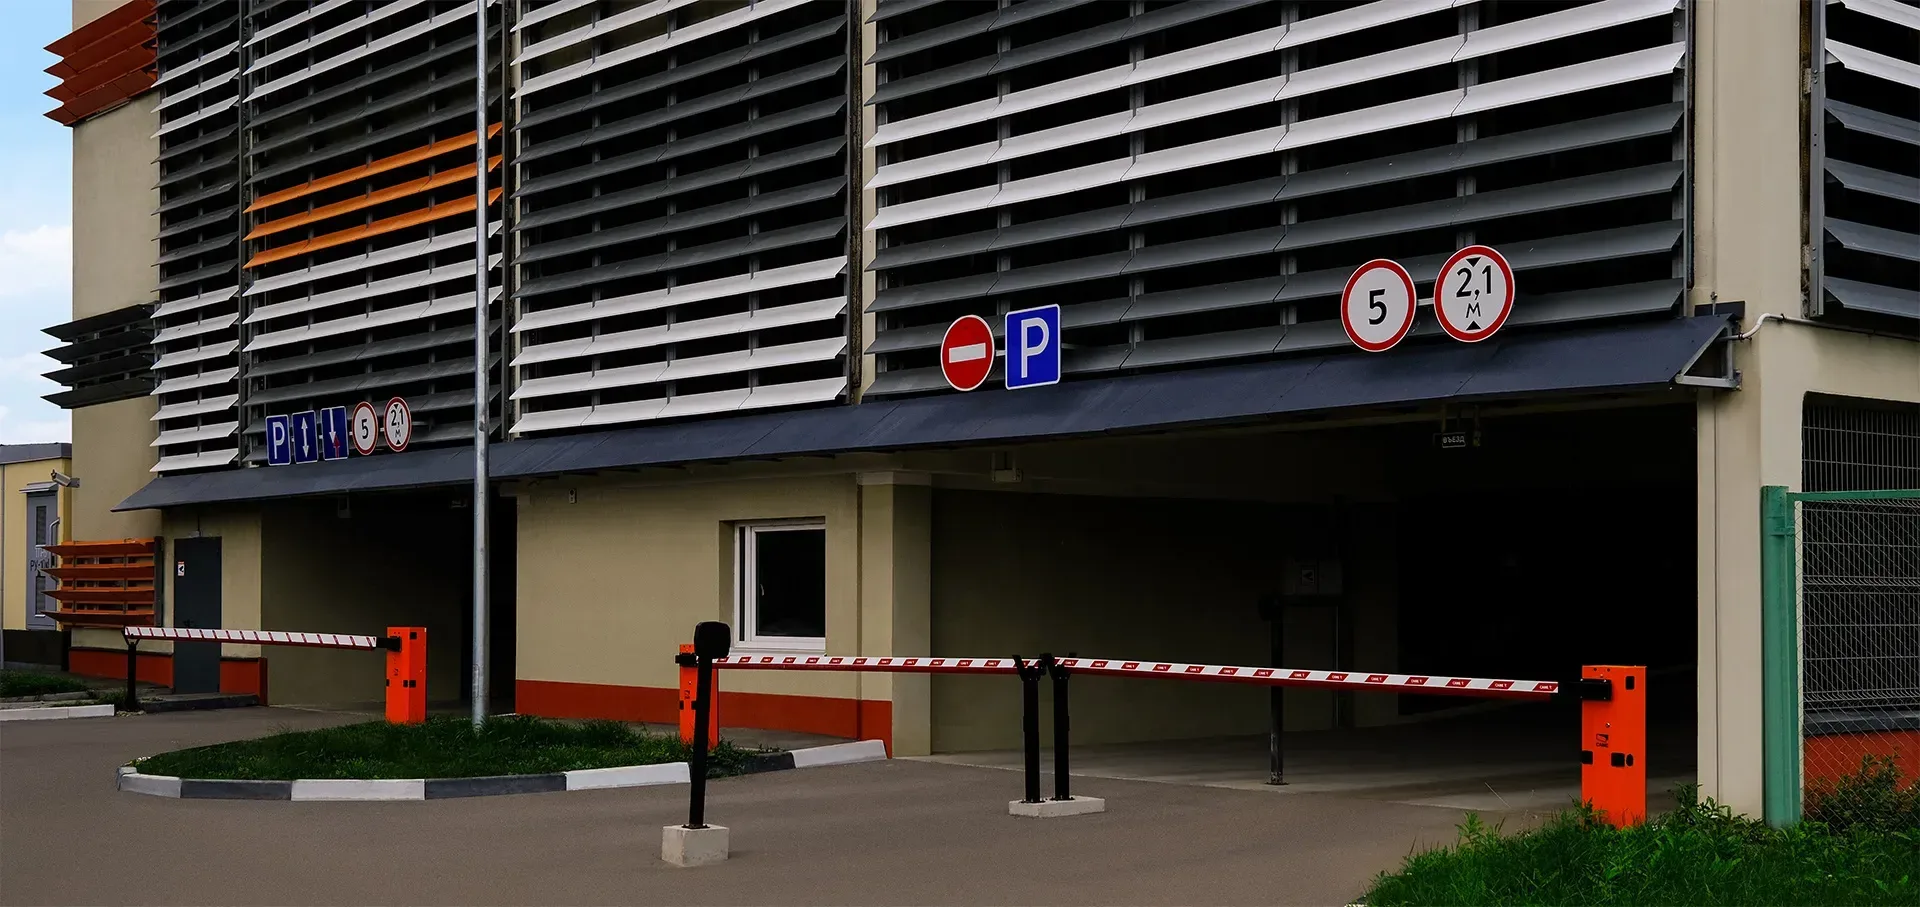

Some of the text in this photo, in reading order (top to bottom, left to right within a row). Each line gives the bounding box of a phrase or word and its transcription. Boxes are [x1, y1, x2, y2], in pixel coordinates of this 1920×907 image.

[1456, 265, 1492, 301] 2,1
[1369, 288, 1388, 325] 5
[1021, 317, 1050, 379] P
[361, 418, 369, 440] 5
[390, 408, 404, 427] 2,1
[272, 421, 285, 460] P
